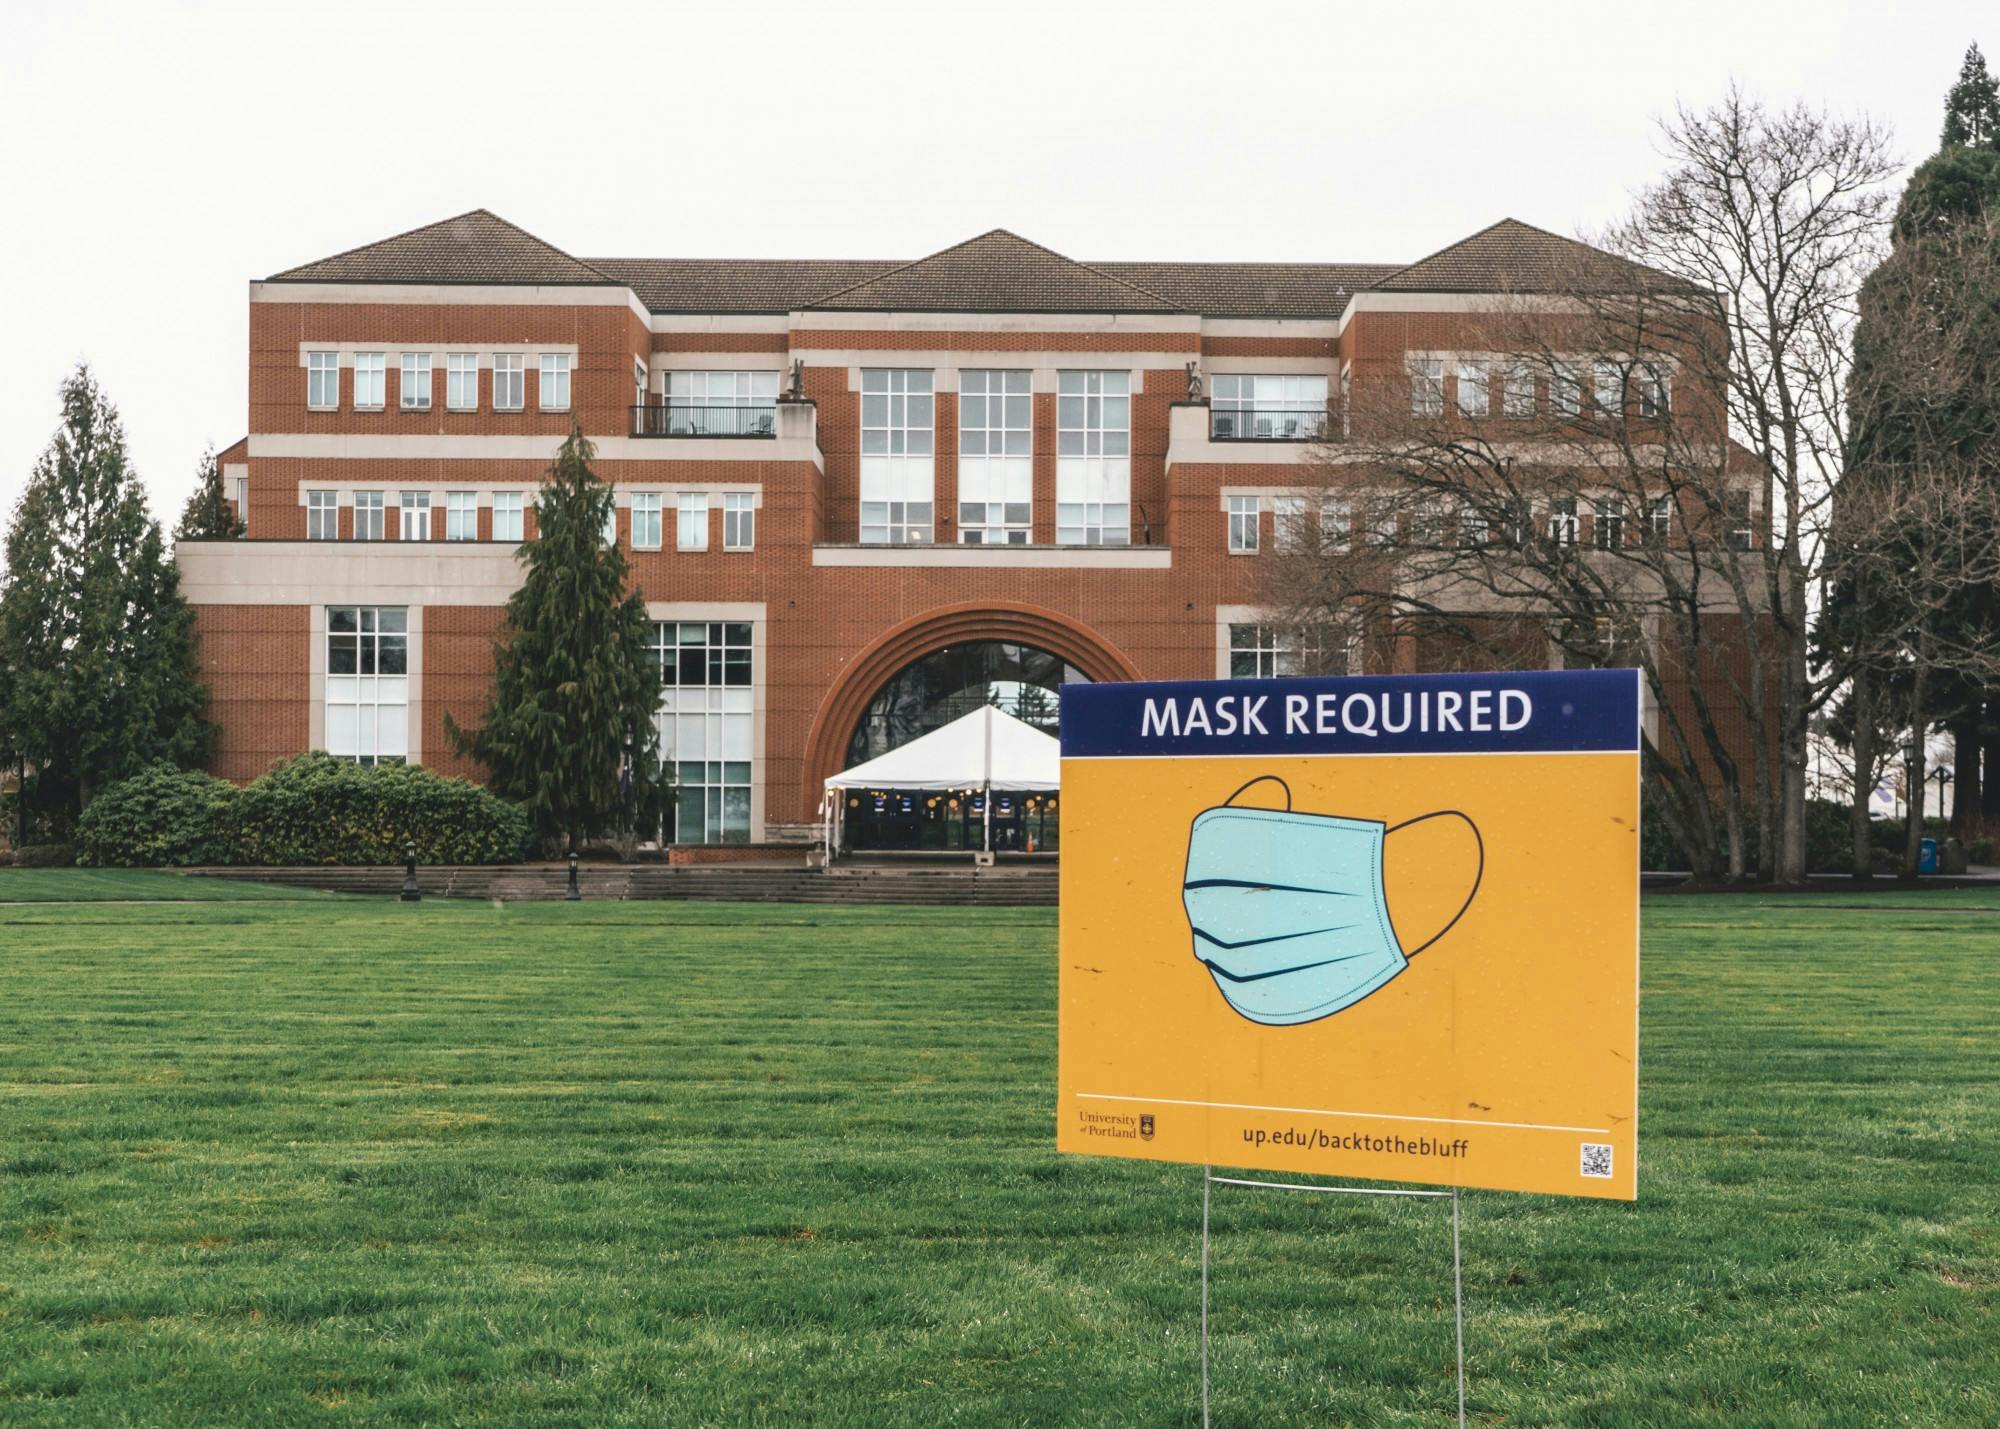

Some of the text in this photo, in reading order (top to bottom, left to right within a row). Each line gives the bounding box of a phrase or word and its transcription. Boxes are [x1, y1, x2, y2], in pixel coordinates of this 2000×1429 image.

[1141, 689, 1532, 738] MASK REQUIRED
[1079, 1111, 1137, 1126] University
[1089, 1125, 1137, 1139] Portland
[1243, 1127, 1469, 1158] up.edu/backtothebluff
